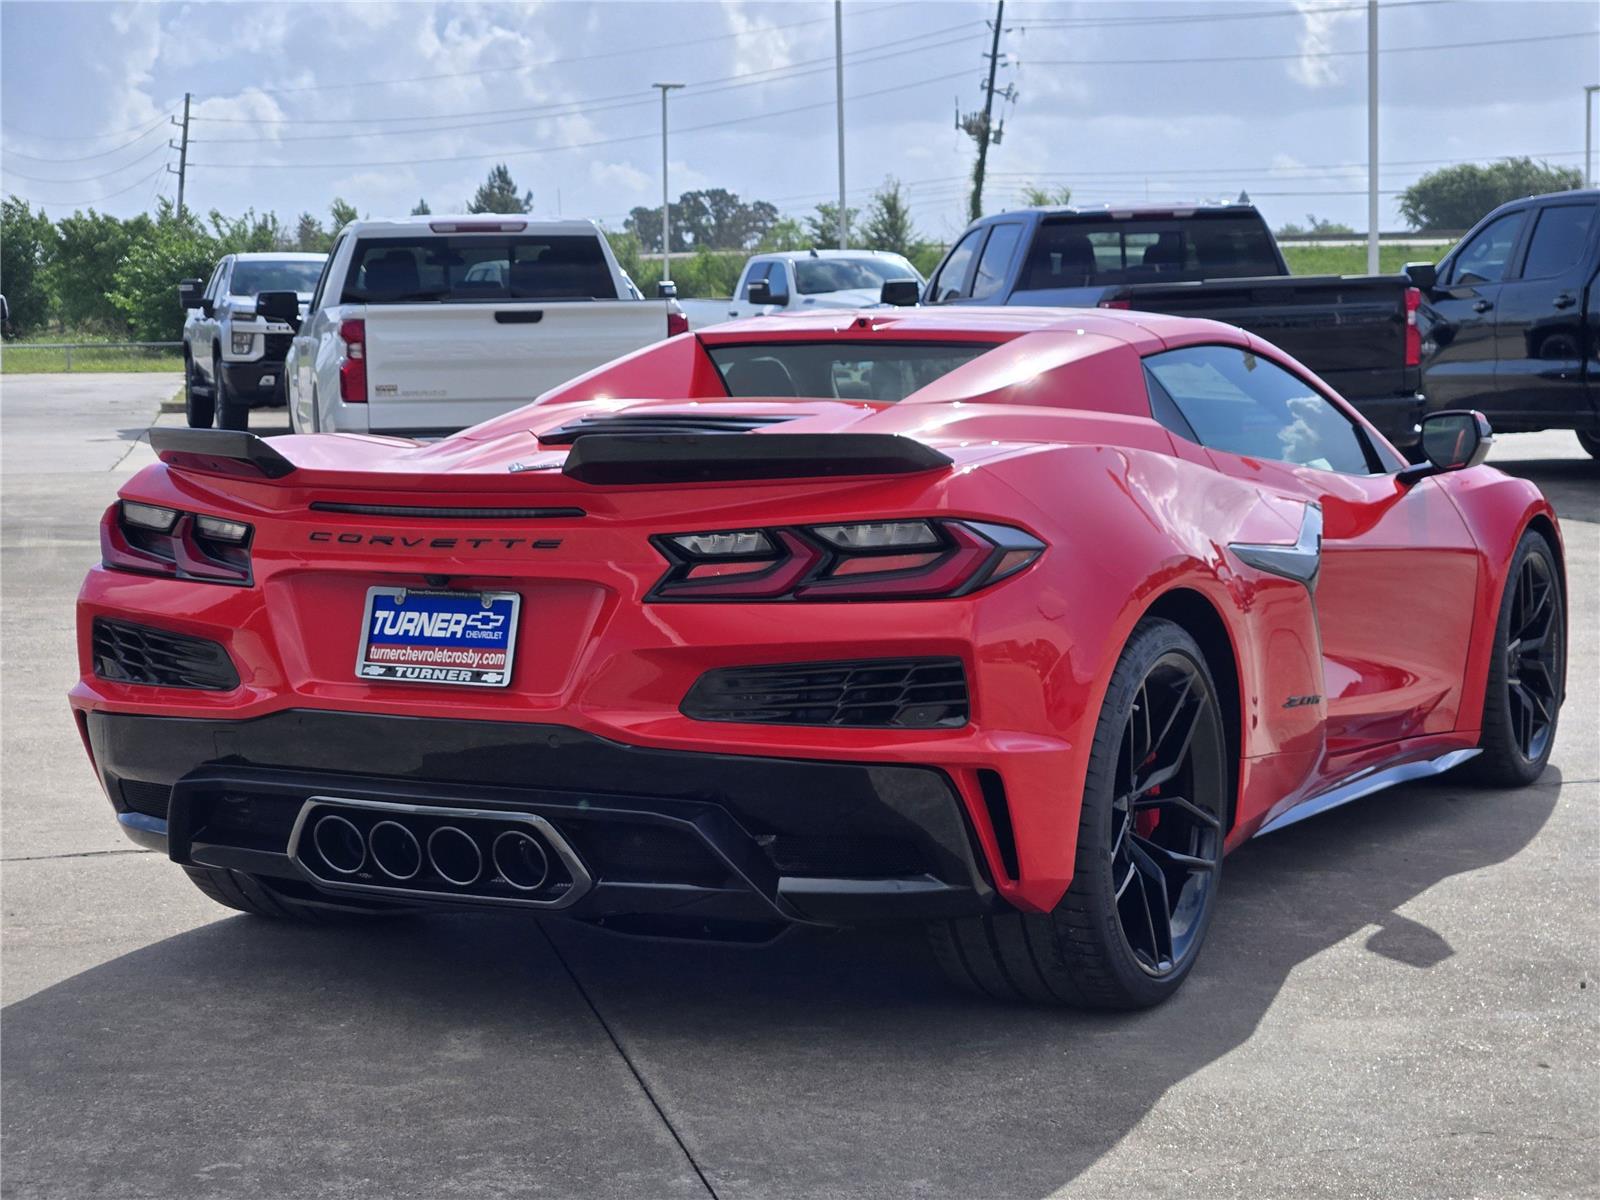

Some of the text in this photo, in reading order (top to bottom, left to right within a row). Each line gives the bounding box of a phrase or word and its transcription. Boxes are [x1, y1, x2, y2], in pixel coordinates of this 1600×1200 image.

[308, 531, 564, 549] CORVETTE
[373, 610, 468, 638] TURNER
[465, 630, 503, 640] CHEVROLET
[369, 645, 506, 668] turnerchevroletcrosby.com
[395, 666, 472, 682] TURNER
